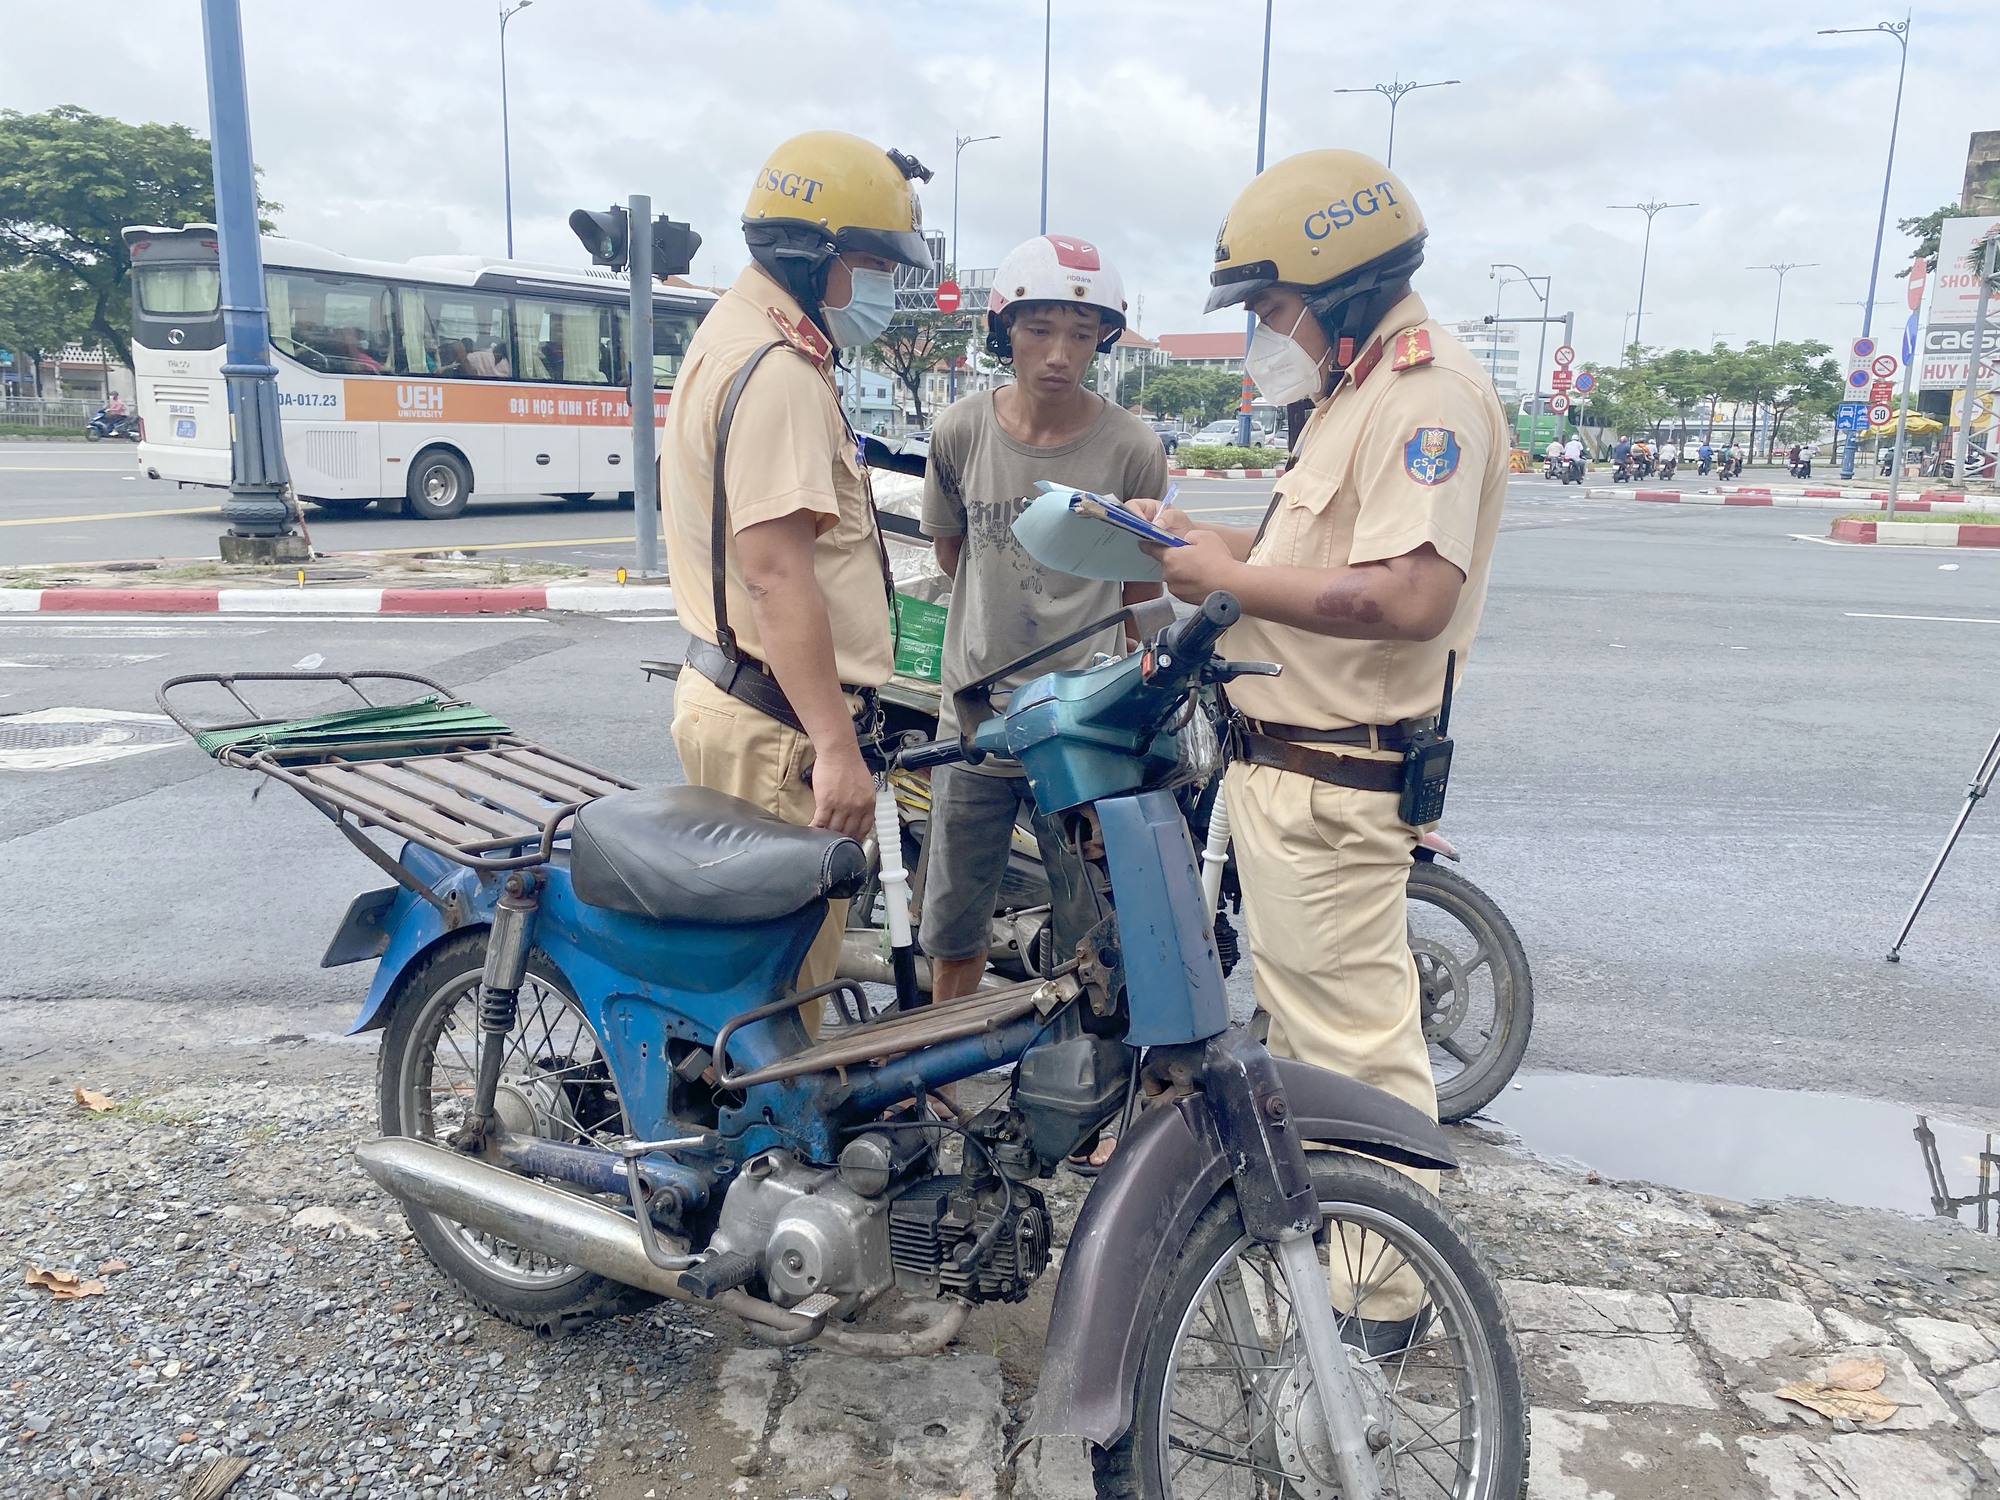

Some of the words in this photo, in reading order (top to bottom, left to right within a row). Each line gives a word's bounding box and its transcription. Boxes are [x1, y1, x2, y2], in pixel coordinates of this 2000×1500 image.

[756, 167, 823, 204] CSGT
[1304, 181, 1398, 240] CSGT
[1926, 329, 2000, 350] caes
[1923, 364, 1958, 379] HUY
[278, 393, 337, 407] 0A-017.23
[397, 385, 443, 410] UEH
[1554, 398, 1565, 408] 60
[397, 410, 443, 418] UNIVERSITY
[510, 398, 529, 417] ĐẠI
[532, 398, 554, 418] HỌC
[558, 400, 582, 416] KINH
[585, 398, 600, 416] TẾ
[1874, 409, 1886, 420] 50
